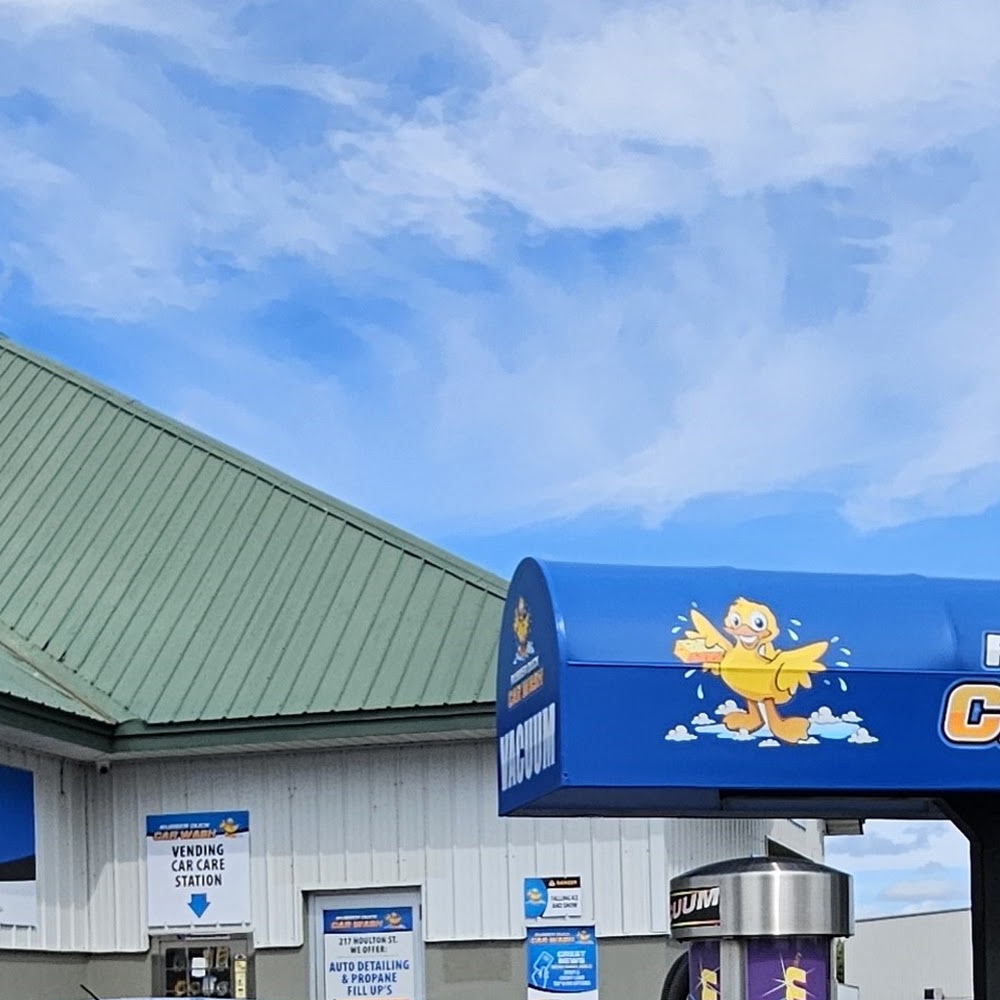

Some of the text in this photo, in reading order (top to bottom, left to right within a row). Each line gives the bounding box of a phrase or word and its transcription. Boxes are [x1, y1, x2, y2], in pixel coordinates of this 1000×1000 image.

[500, 702, 555, 791] VACUUM
[172, 844, 224, 858] VENDING
[171, 858, 225, 872] CAR CARE
[175, 874, 222, 888] STATION
[339, 937, 351, 946] 217
[350, 946, 361, 954] WE
[329, 959, 410, 972] AUTO DETAILING
[341, 972, 397, 984] & PROPANE
[347, 984, 392, 996] FILL UP'S
